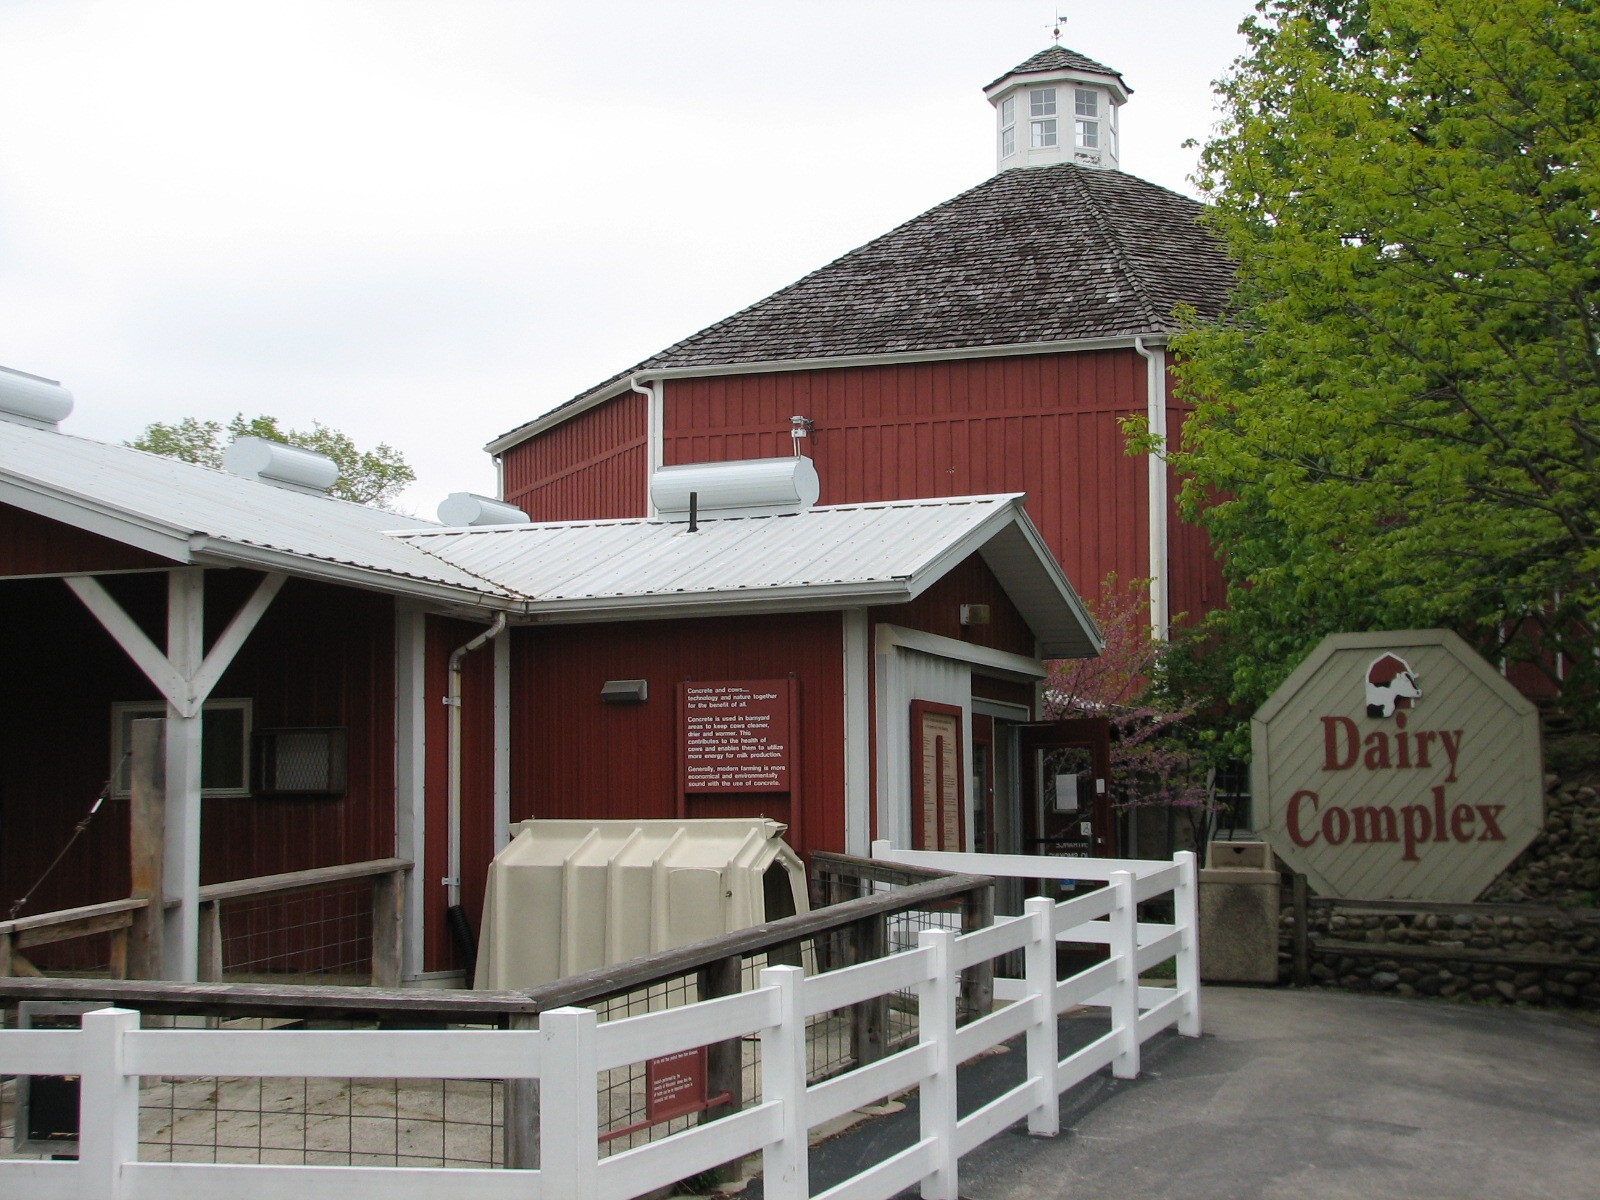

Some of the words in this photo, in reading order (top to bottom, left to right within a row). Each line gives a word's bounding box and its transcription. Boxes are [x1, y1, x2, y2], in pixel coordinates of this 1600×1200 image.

[1320, 711, 1464, 782] Dairy
[735, 771, 778, 780] environmentally
[741, 764, 762, 773] farming
[1286, 785, 1506, 861] Complex
